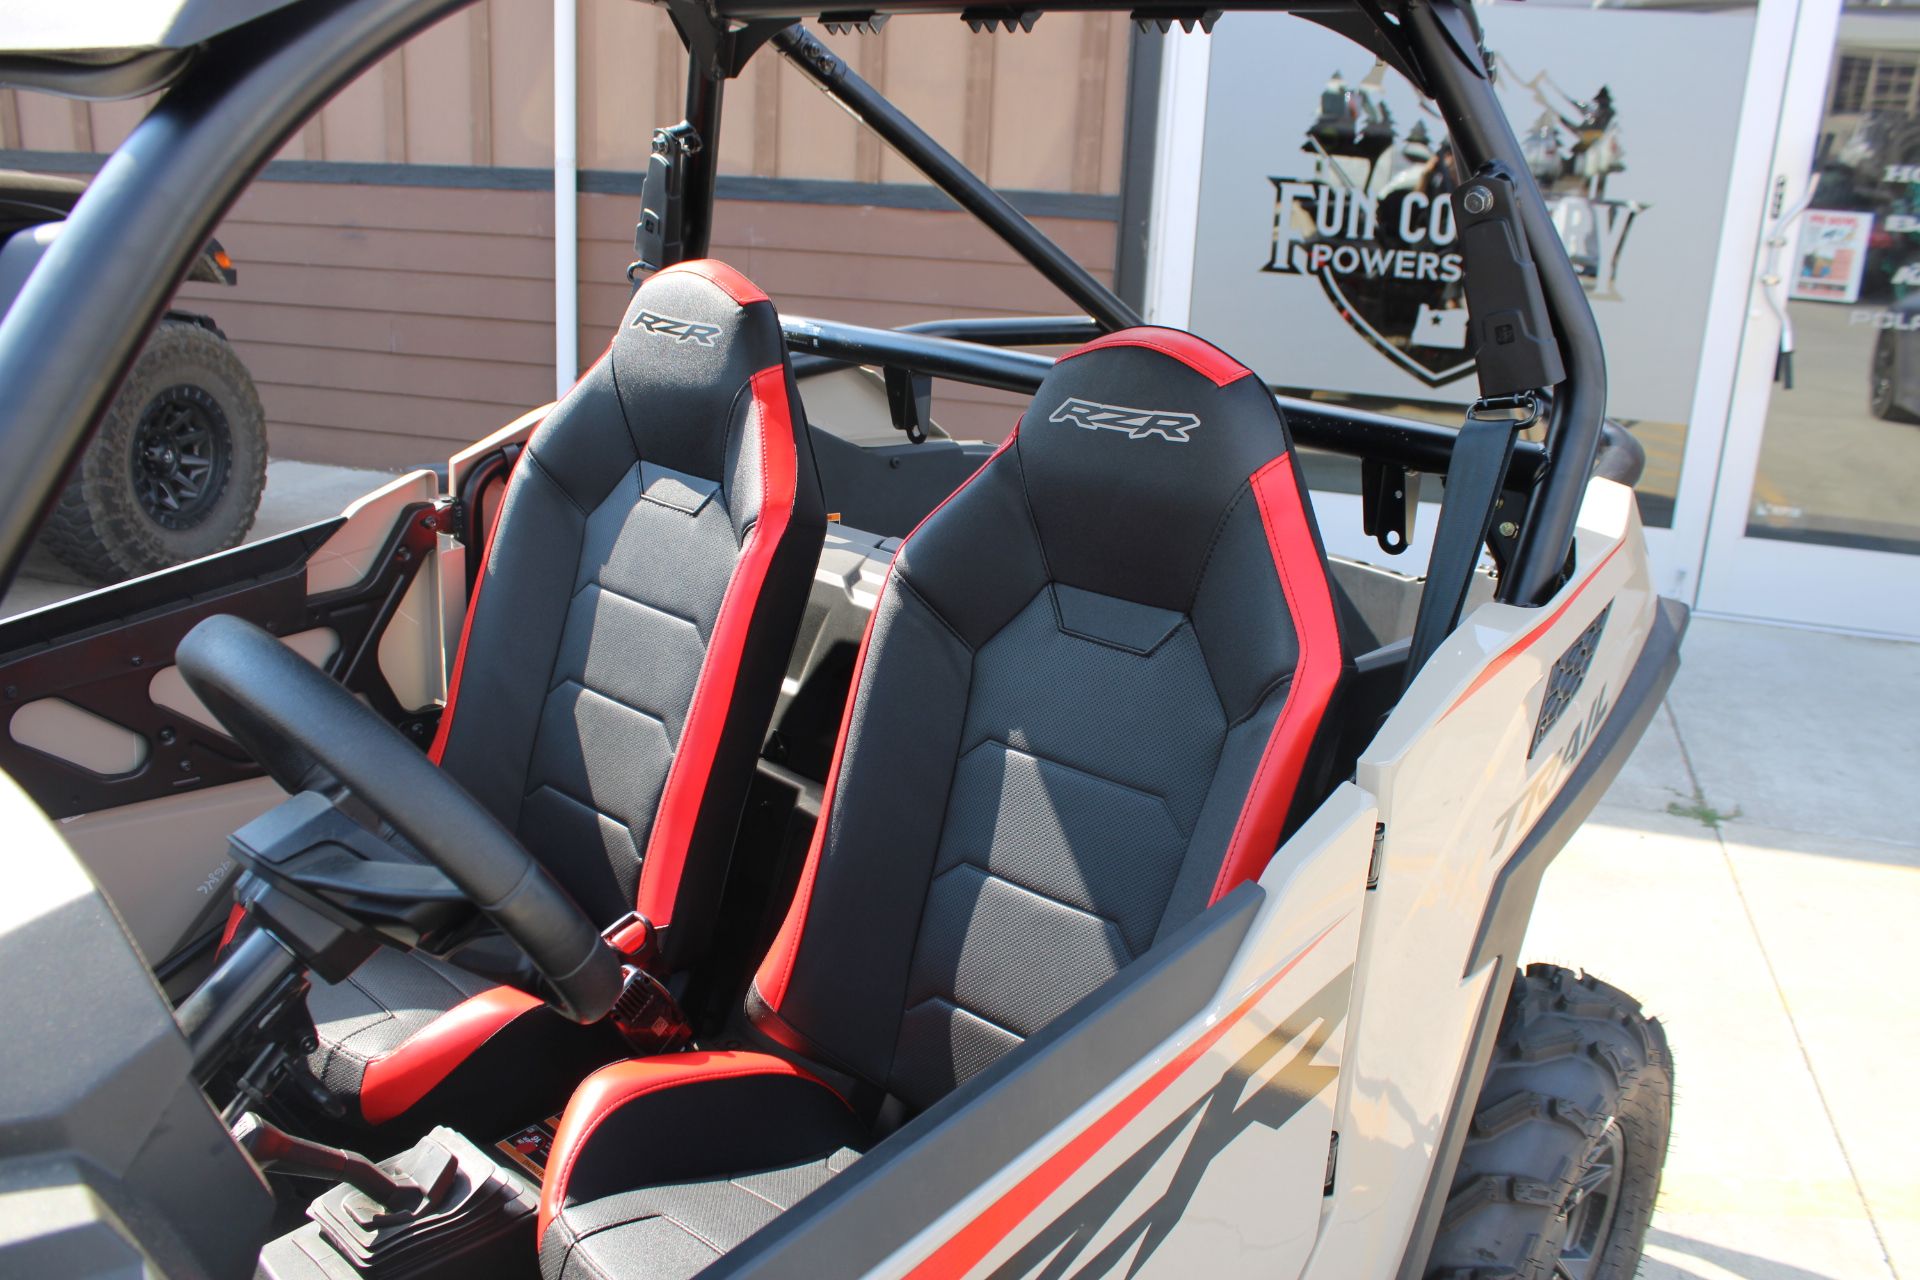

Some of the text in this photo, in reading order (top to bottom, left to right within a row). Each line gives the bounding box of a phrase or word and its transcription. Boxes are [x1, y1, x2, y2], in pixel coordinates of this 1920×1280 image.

[1262, 177, 1377, 274] FUN
[630, 308, 722, 347] RZR
[1049, 397, 1201, 442] RZR
[1490, 681, 1609, 861] TRAIL
